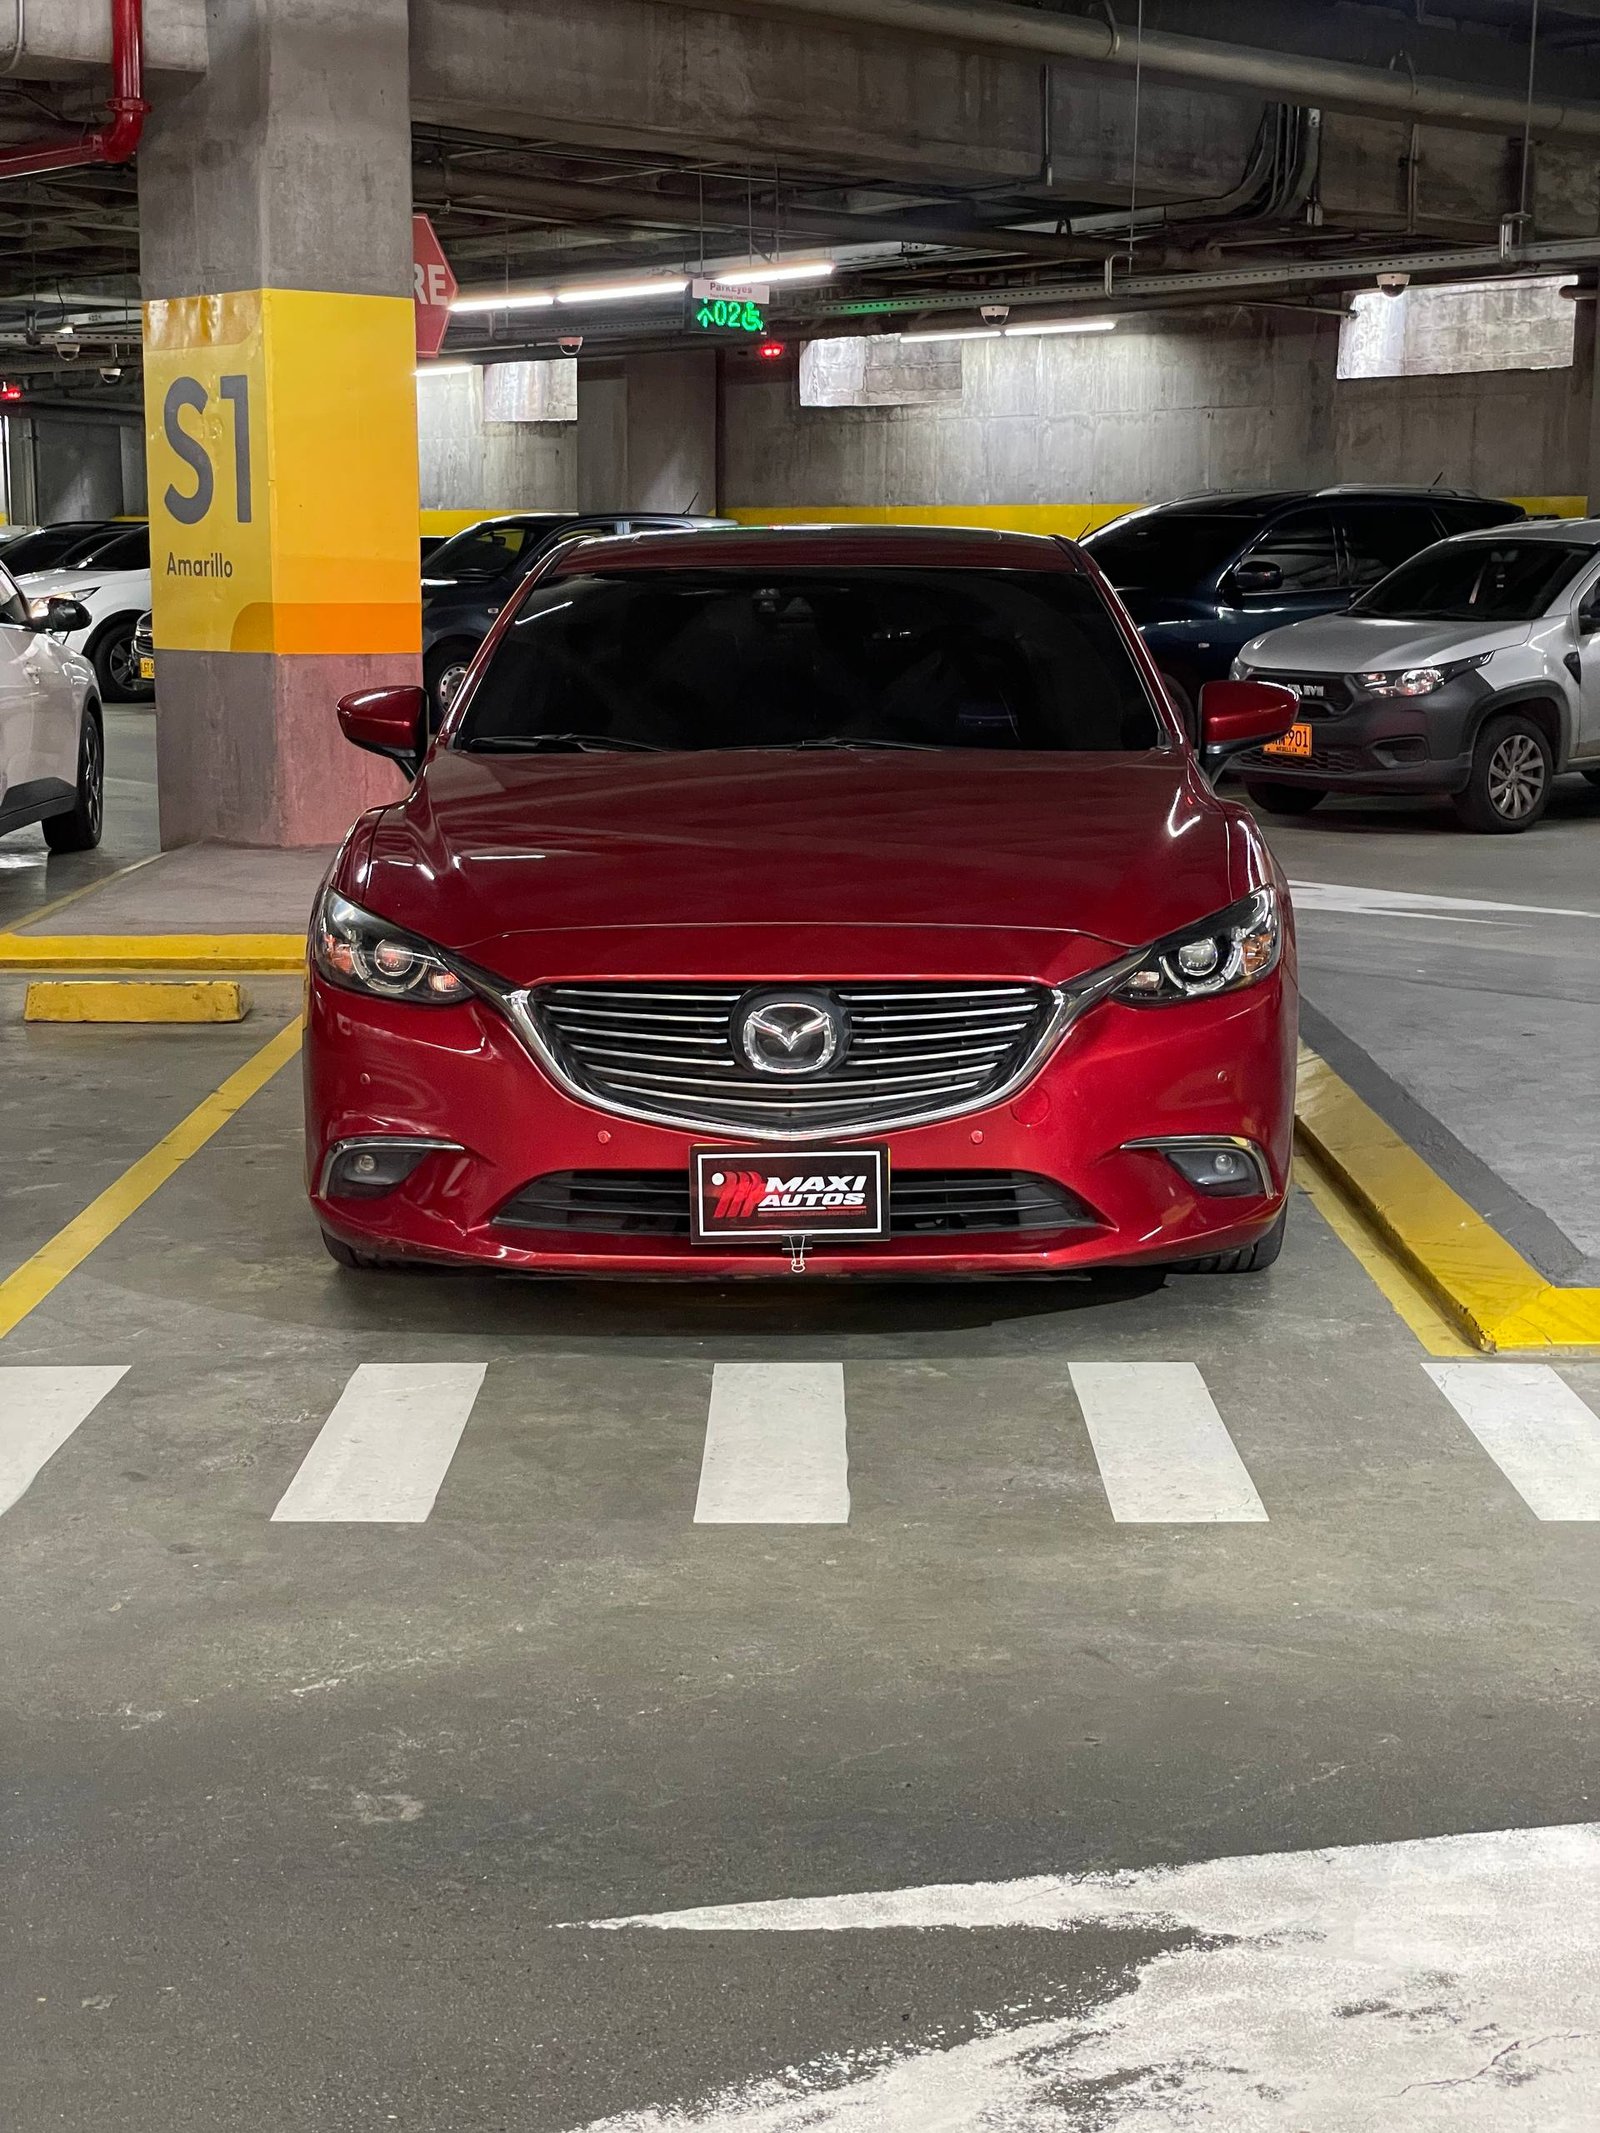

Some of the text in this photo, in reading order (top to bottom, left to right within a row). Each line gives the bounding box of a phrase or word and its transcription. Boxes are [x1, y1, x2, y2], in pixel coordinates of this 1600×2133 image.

[414, 264, 448, 306] RE
[714, 300, 741, 328] 02
[164, 375, 252, 525] S1
[166, 552, 233, 578] Amarillo
[1287, 683, 1324, 697] AM
[765, 1175, 868, 1193] MAXI
[758, 1192, 866, 1208] AUTOS
